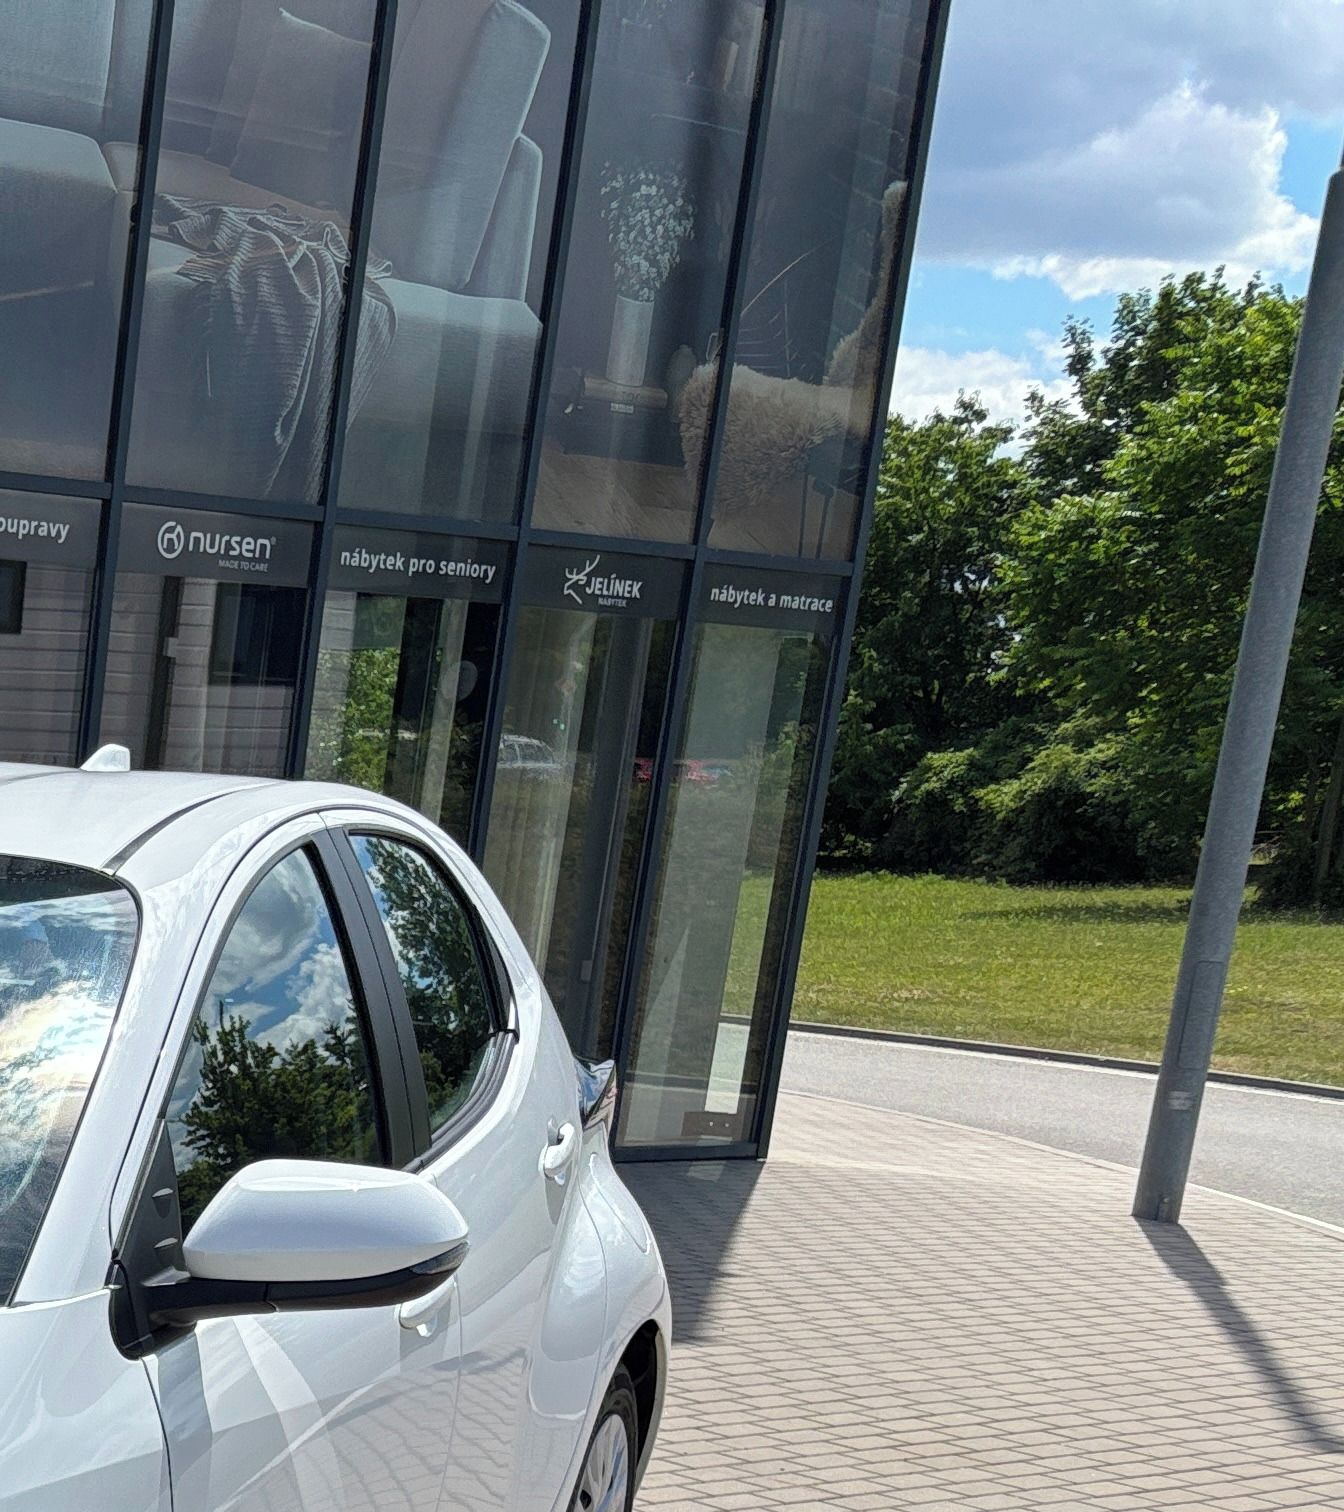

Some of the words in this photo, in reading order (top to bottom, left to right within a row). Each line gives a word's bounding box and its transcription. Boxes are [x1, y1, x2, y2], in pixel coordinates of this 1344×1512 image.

[340, 548, 405, 573] nábytek
[408, 557, 436, 576] pro
[438, 559, 496, 584] seniory
[585, 573, 643, 599] JELÍNEK
[710, 585, 766, 608] nábytek
[767, 593, 777, 607] a
[779, 594, 834, 613] matrace
